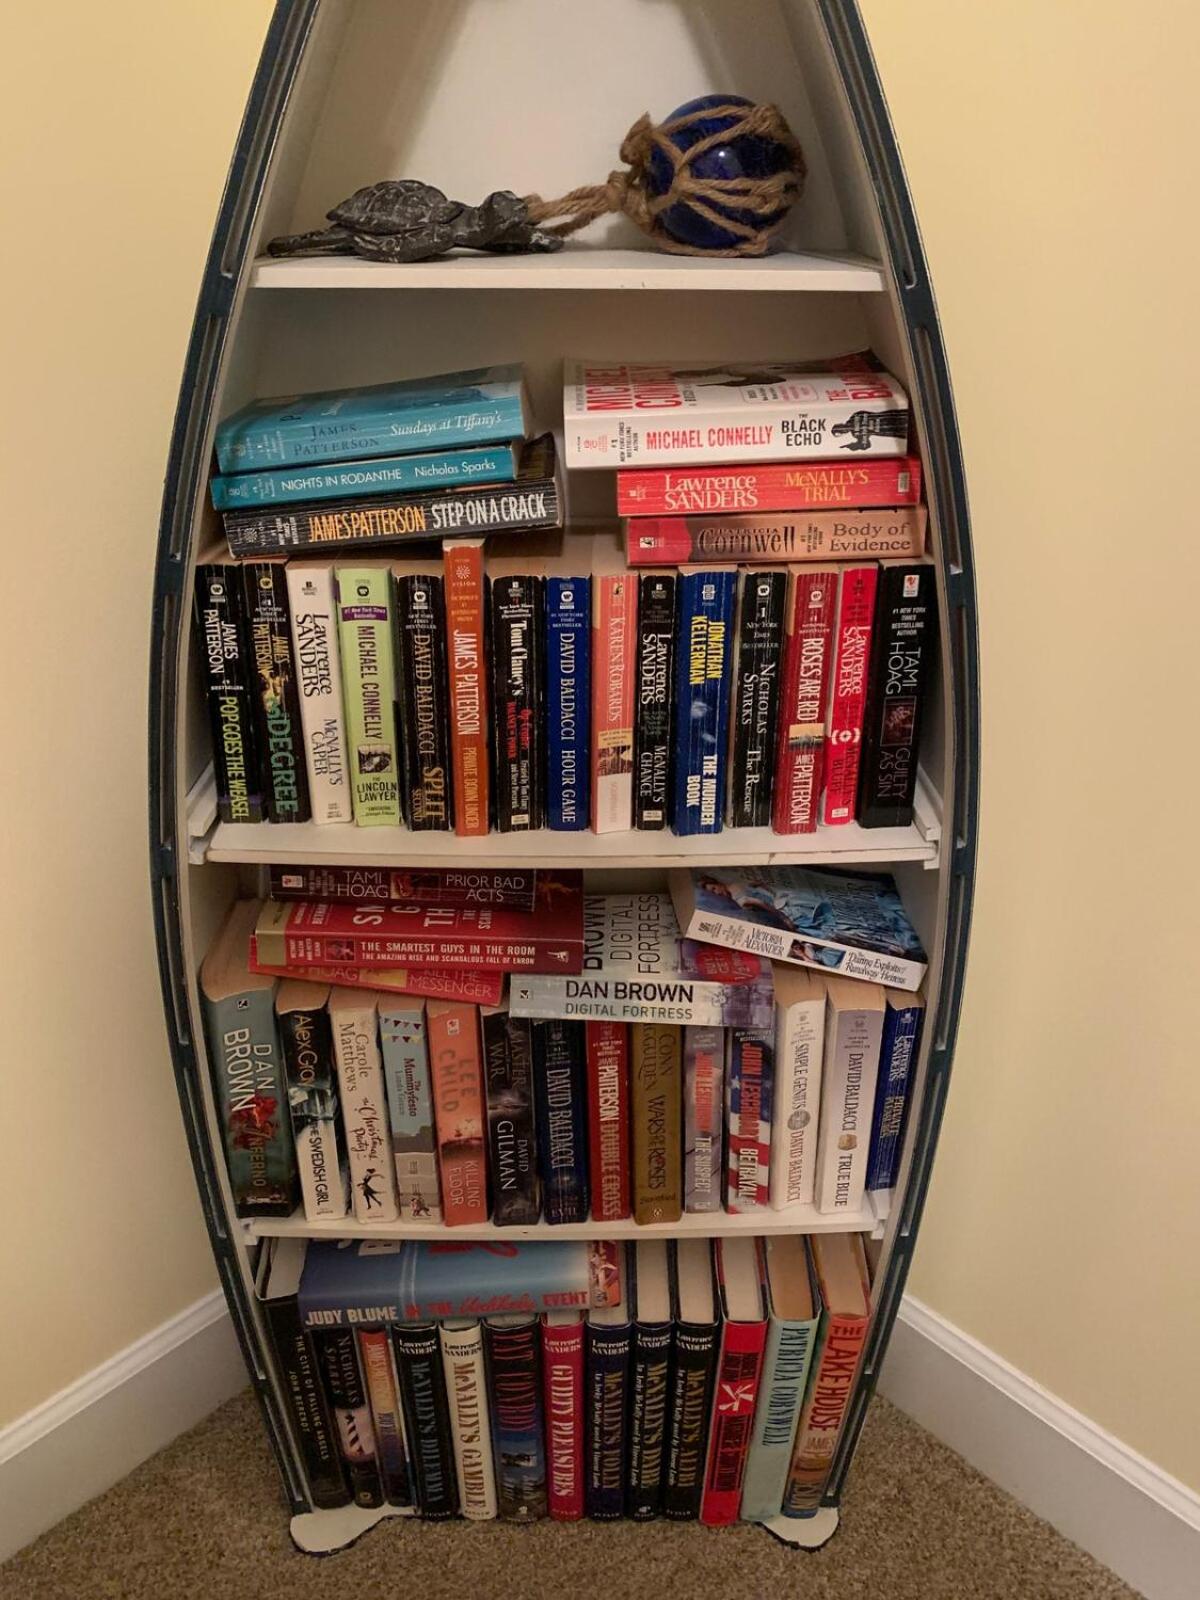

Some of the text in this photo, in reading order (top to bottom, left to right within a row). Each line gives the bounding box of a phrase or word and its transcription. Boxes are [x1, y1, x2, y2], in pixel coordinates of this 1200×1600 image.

[391, 410, 502, 436] Sundays at Tiffany's
[646, 425, 773, 450] MICHAEL CONNELLY
[781, 418, 827, 434] BLACK
[786, 432, 823, 447] ECHO
[294, 436, 379, 457] PATTERSON
[415, 458, 496, 478] Nicholas Sparks
[281, 468, 402, 492] NIGHTS IN RODANTHE
[664, 489, 758, 511] SANDERS
[665, 474, 756, 491] Lawrence
[786, 469, 869, 487] McNALLY'S
[801, 484, 851, 502] TRIAL
[308, 515, 351, 543] JAMES
[350, 506, 427, 537] PATTERSON
[431, 492, 547, 530] STEP ON A CRACK
[832, 522, 880, 542] Body
[887, 522, 909, 536] of
[699, 526, 795, 554] Cornwell
[829, 538, 911, 552] Evidence
[203, 608, 225, 675] PATTERSON
[221, 620, 239, 661] JAMES
[253, 622, 275, 676] PATTERSON
[272, 634, 291, 665] JAMES
[296, 612, 320, 698] SANDERS
[312, 613, 333, 694] Lawrence
[507, 620, 529, 697] Tom Clancy's
[608, 616, 625, 666] KAREN
[689, 615, 707, 685] KELLERMAN
[706, 621, 725, 680] JONATHAN
[838, 628, 856, 698] SANDERS
[850, 625, 871, 695] Lawrence
[357, 625, 383, 740] MICHAEL CONNELLY
[453, 629, 480, 737] JAMES PATTERSON
[560, 632, 576, 742] DAVID BALDACCI
[641, 632, 656, 706] SANDERS
[652, 632, 671, 703] Lawrence
[797, 637, 825, 721] ROSES ARE RED
[885, 641, 906, 696] HOAG
[901, 646, 922, 689] TAMI
[414, 634, 437, 755] DAVID BALDACCI
[608, 665, 625, 723] ROBARDS
[218, 696, 250, 819] POP GOES THE WEASEL
[268, 718, 299, 814] DEGREE
[312, 731, 329, 776] CAPER
[323, 718, 343, 787] McNALLY'S
[640, 751, 653, 797] CHANCE
[894, 747, 911, 800] GUILTY
[357, 781, 398, 793] LINCOLN
[359, 791, 397, 803] LAWYER
[421, 765, 445, 822] SPLIT
[561, 749, 576, 824] HOUR GAME
[686, 775, 701, 808] BOOK
[701, 754, 718, 826] THE MURDER
[790, 763, 815, 825] PATTERSON
[337, 884, 388, 898] HOAG
[343, 870, 382, 884] TAMI
[446, 874, 525, 890] PRIOR BAD
[466, 888, 504, 902] ACTS
[361, 941, 536, 956] THE SMARTEST GUYS IN THE ROOM
[610, 900, 634, 962] DIGITAL
[637, 893, 661, 975] FORTRESS
[362, 952, 535, 965] THE AMAZING RISE AND SCANDALOUS FALL OF ENRON
[409, 976, 492, 998] MESSENGER
[565, 980, 694, 1003] DAN BROWN
[565, 1002, 693, 1020] DIGITAL FORTRESS
[223, 1027, 256, 1112] BROWN
[252, 1043, 275, 1091] DAN
[339, 1022, 358, 1093] Matthews
[355, 1034, 372, 1079] Carole
[459, 1058, 475, 1097] LEE
[490, 1041, 506, 1078] WAR
[659, 1034, 677, 1076] CONN
[793, 1043, 810, 1075] SIMPLE
[847, 1053, 864, 1085] DAVID
[404, 1057, 418, 1118] Mummyfesto
[438, 1049, 459, 1113] CHILD
[546, 1068, 572, 1107] DAVID
[791, 1076, 809, 1111] GENIUS
[308, 1119, 320, 1136] THE
[842, 1083, 862, 1132] BALDACCI
[309, 1132, 328, 1183] SWEDISH
[497, 1120, 518, 1191] GILMAN
[518, 1139, 530, 1172] DAVID
[548, 1110, 575, 1170] BALDACCI
[598, 1065, 622, 1216] PATTERSON DOUBLE CROSS
[789, 1130, 805, 1158] DAVID
[450, 1166, 465, 1207] FLOOR
[465, 1160, 480, 1209] KILLING
[693, 1136, 712, 1193] THE SUSPECT
[739, 1147, 760, 1198] BETRAYAL
[787, 1158, 804, 1202] BALDACCI
[837, 1153, 853, 1180] TRUE
[315, 1181, 329, 1207] GIRL
[835, 1181, 851, 1208] BLUE
[305, 1306, 398, 1325] JUDY BLUME
[831, 1325, 864, 1334] THE
[819, 1333, 861, 1384] LAKE
[289, 1370, 311, 1433] JOHN BERENDT
[295, 1335, 330, 1461] THE CITY OF FALLING ANGELS
[762, 1326, 810, 1447] PATRICIA CORNWELL
[808, 1385, 850, 1432] HOUSE
[551, 1364, 575, 1497] GUILTY PLEASURES
[602, 1370, 624, 1489] McNALLY'S FOLLY
